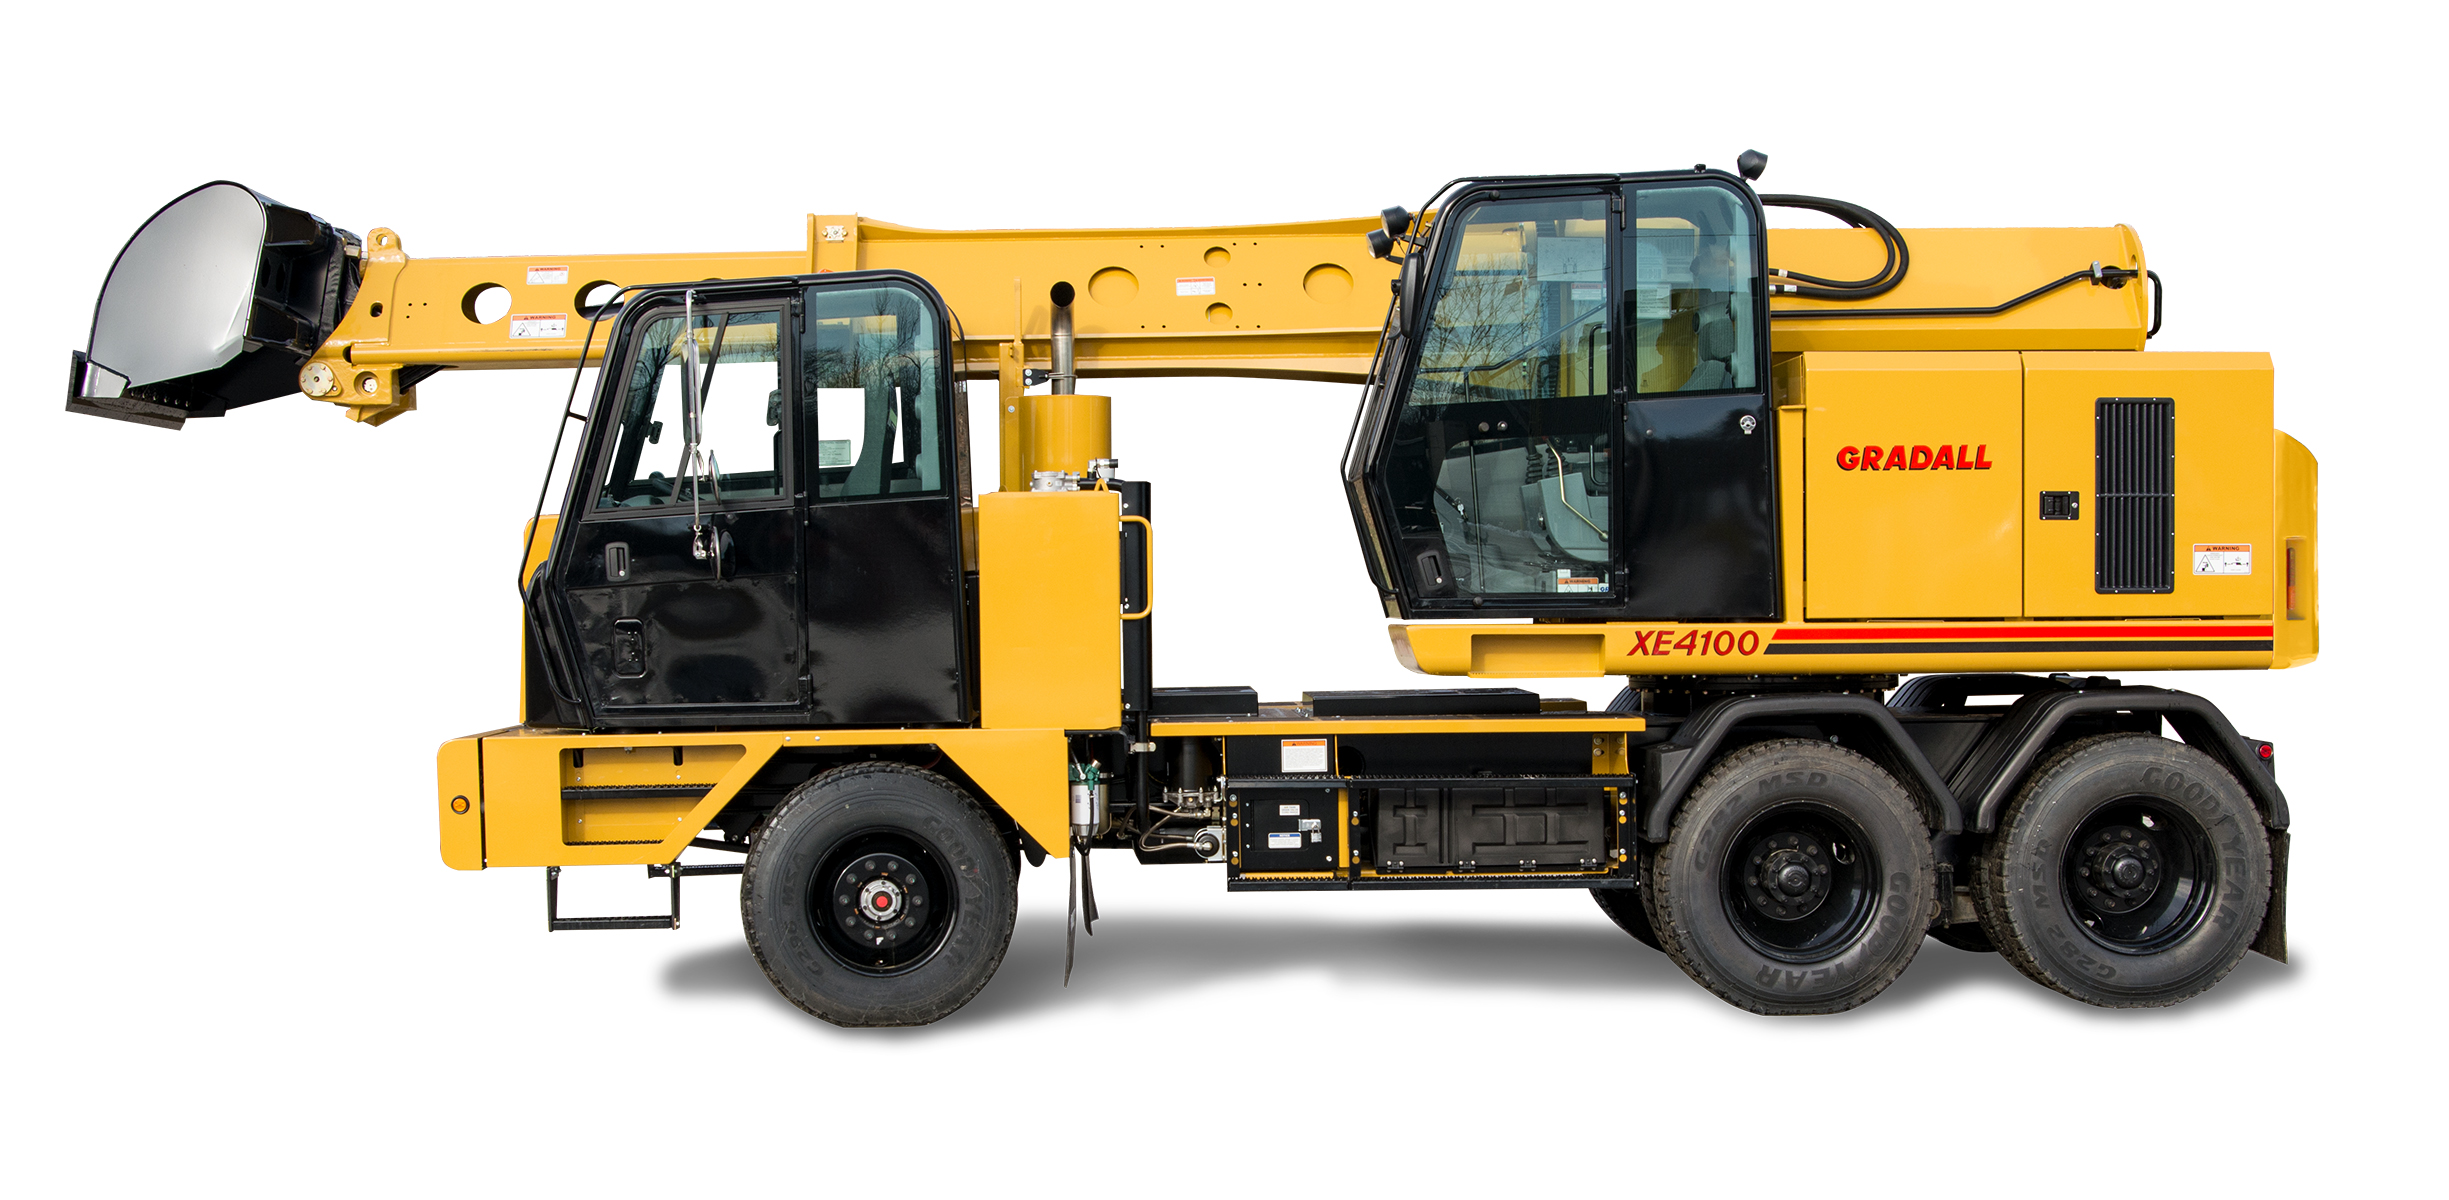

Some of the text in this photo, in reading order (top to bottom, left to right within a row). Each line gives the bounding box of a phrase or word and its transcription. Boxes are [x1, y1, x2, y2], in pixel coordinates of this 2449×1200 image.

[1836, 444, 1993, 471] GRADALL
[1626, 629, 1760, 656] XE4100
[1694, 772, 1829, 873] G282 MSD
[2046, 922, 2118, 980] G282
